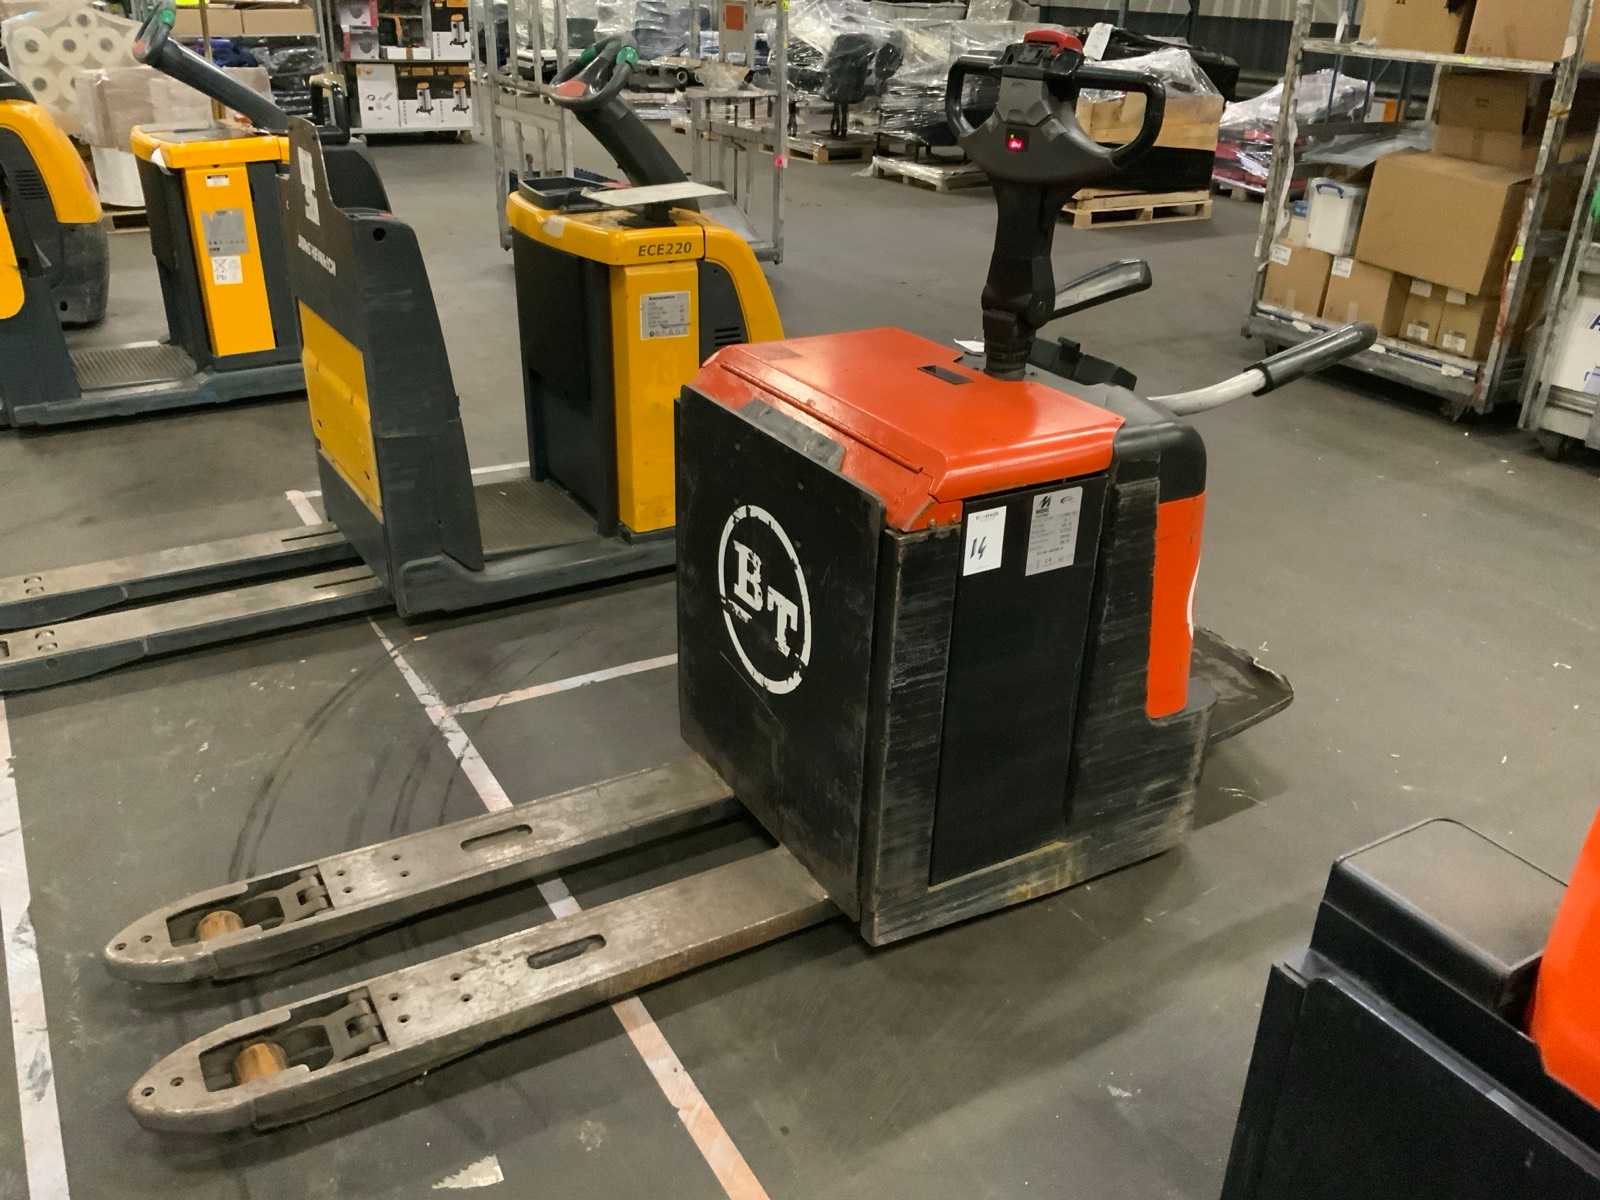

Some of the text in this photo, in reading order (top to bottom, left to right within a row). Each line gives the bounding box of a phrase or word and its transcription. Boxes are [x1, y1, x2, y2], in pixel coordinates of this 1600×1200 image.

[638, 242, 693, 257] ECE220
[969, 535, 987, 561] 14
[732, 539, 800, 658] BT
